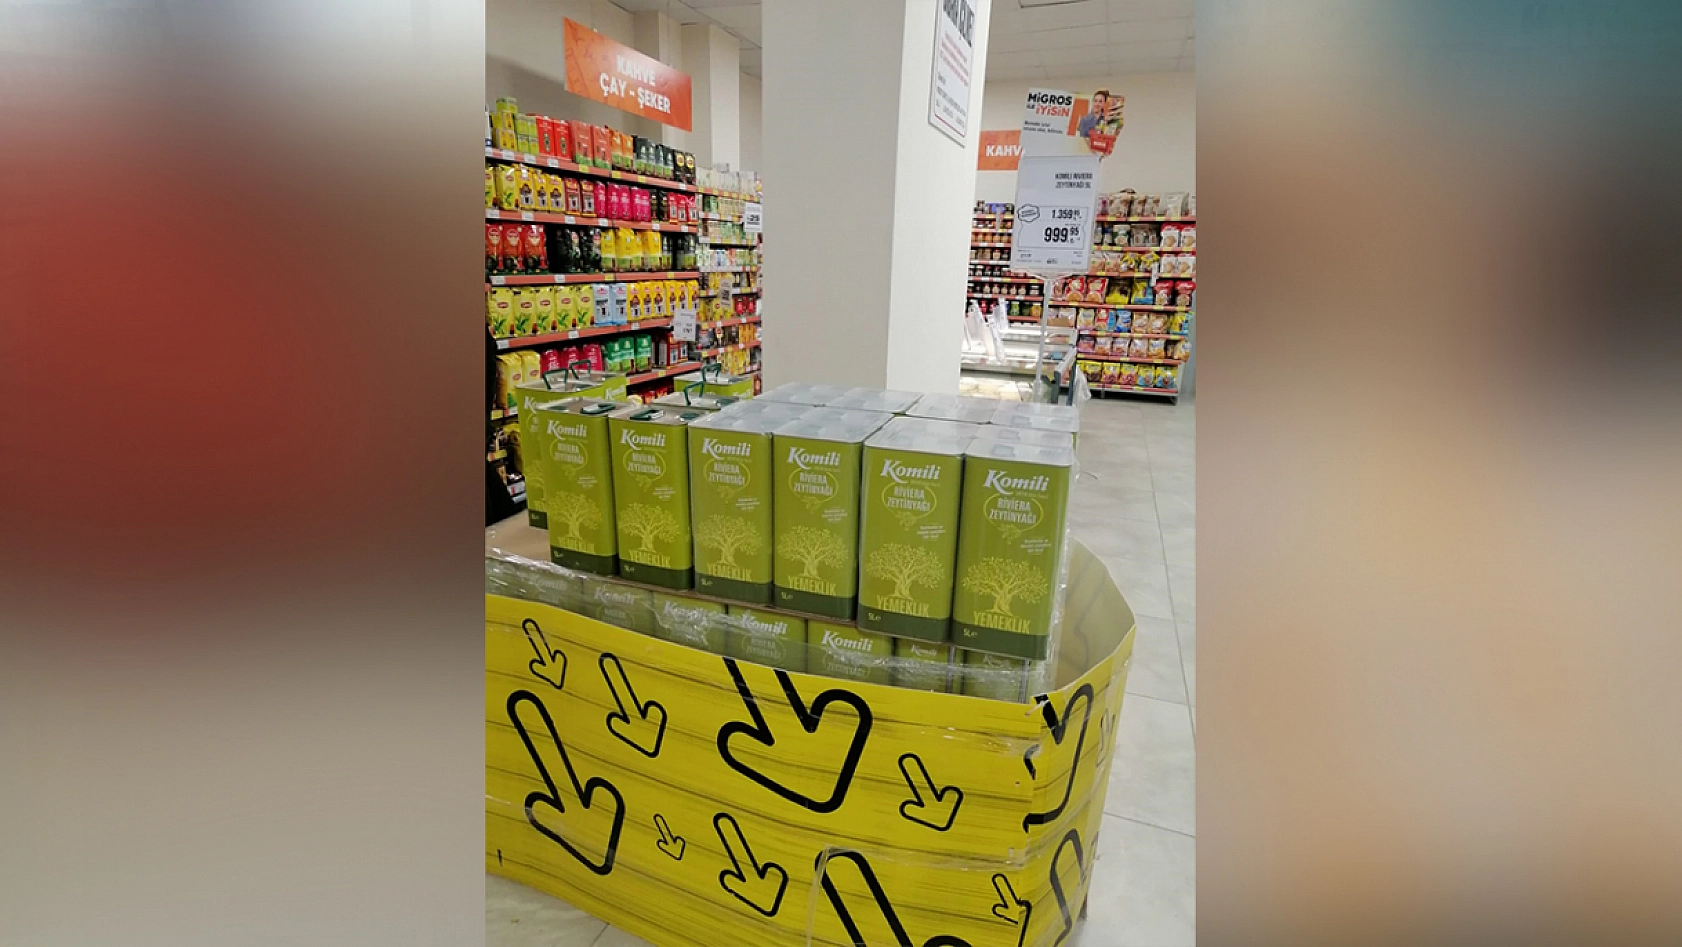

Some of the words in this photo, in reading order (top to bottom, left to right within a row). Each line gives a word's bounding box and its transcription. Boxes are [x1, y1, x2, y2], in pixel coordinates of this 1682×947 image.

[617, 54, 656, 87] KAHVE
[600, 72, 627, 98] ÇAY
[637, 86, 671, 114] ŞEKER
[985, 144, 1024, 157] KAHV
[547, 419, 587, 440] Komili
[620, 428, 666, 450] Komili
[701, 437, 751, 460] Komili
[787, 446, 841, 470] Komili
[880, 459, 941, 483] Komili
[982, 470, 1050, 495] Komili
[740, 611, 788, 636] Komili
[821, 630, 874, 655] Komili
